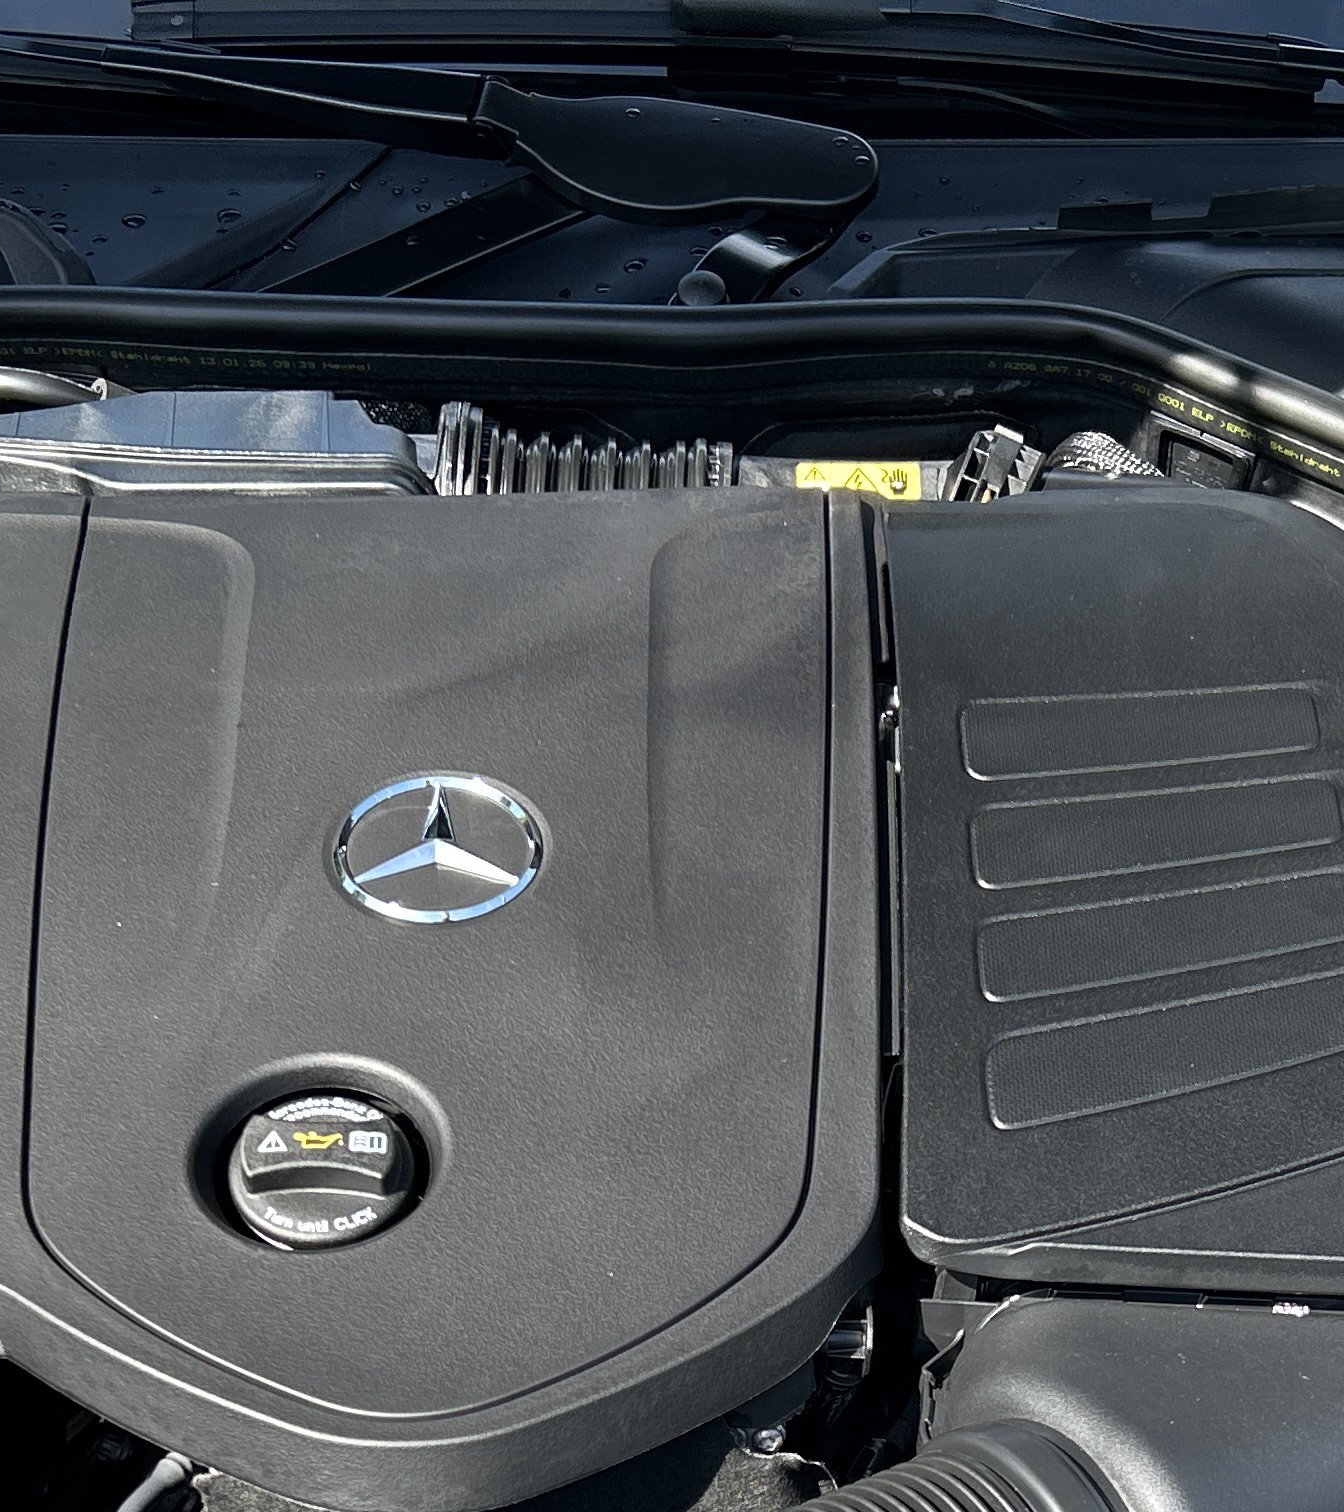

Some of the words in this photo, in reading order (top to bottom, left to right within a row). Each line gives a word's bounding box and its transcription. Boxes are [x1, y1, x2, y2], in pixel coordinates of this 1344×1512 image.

[264, 1205, 295, 1230] Turn
[297, 1219, 330, 1234] until
[333, 1205, 379, 1232] CLICK
